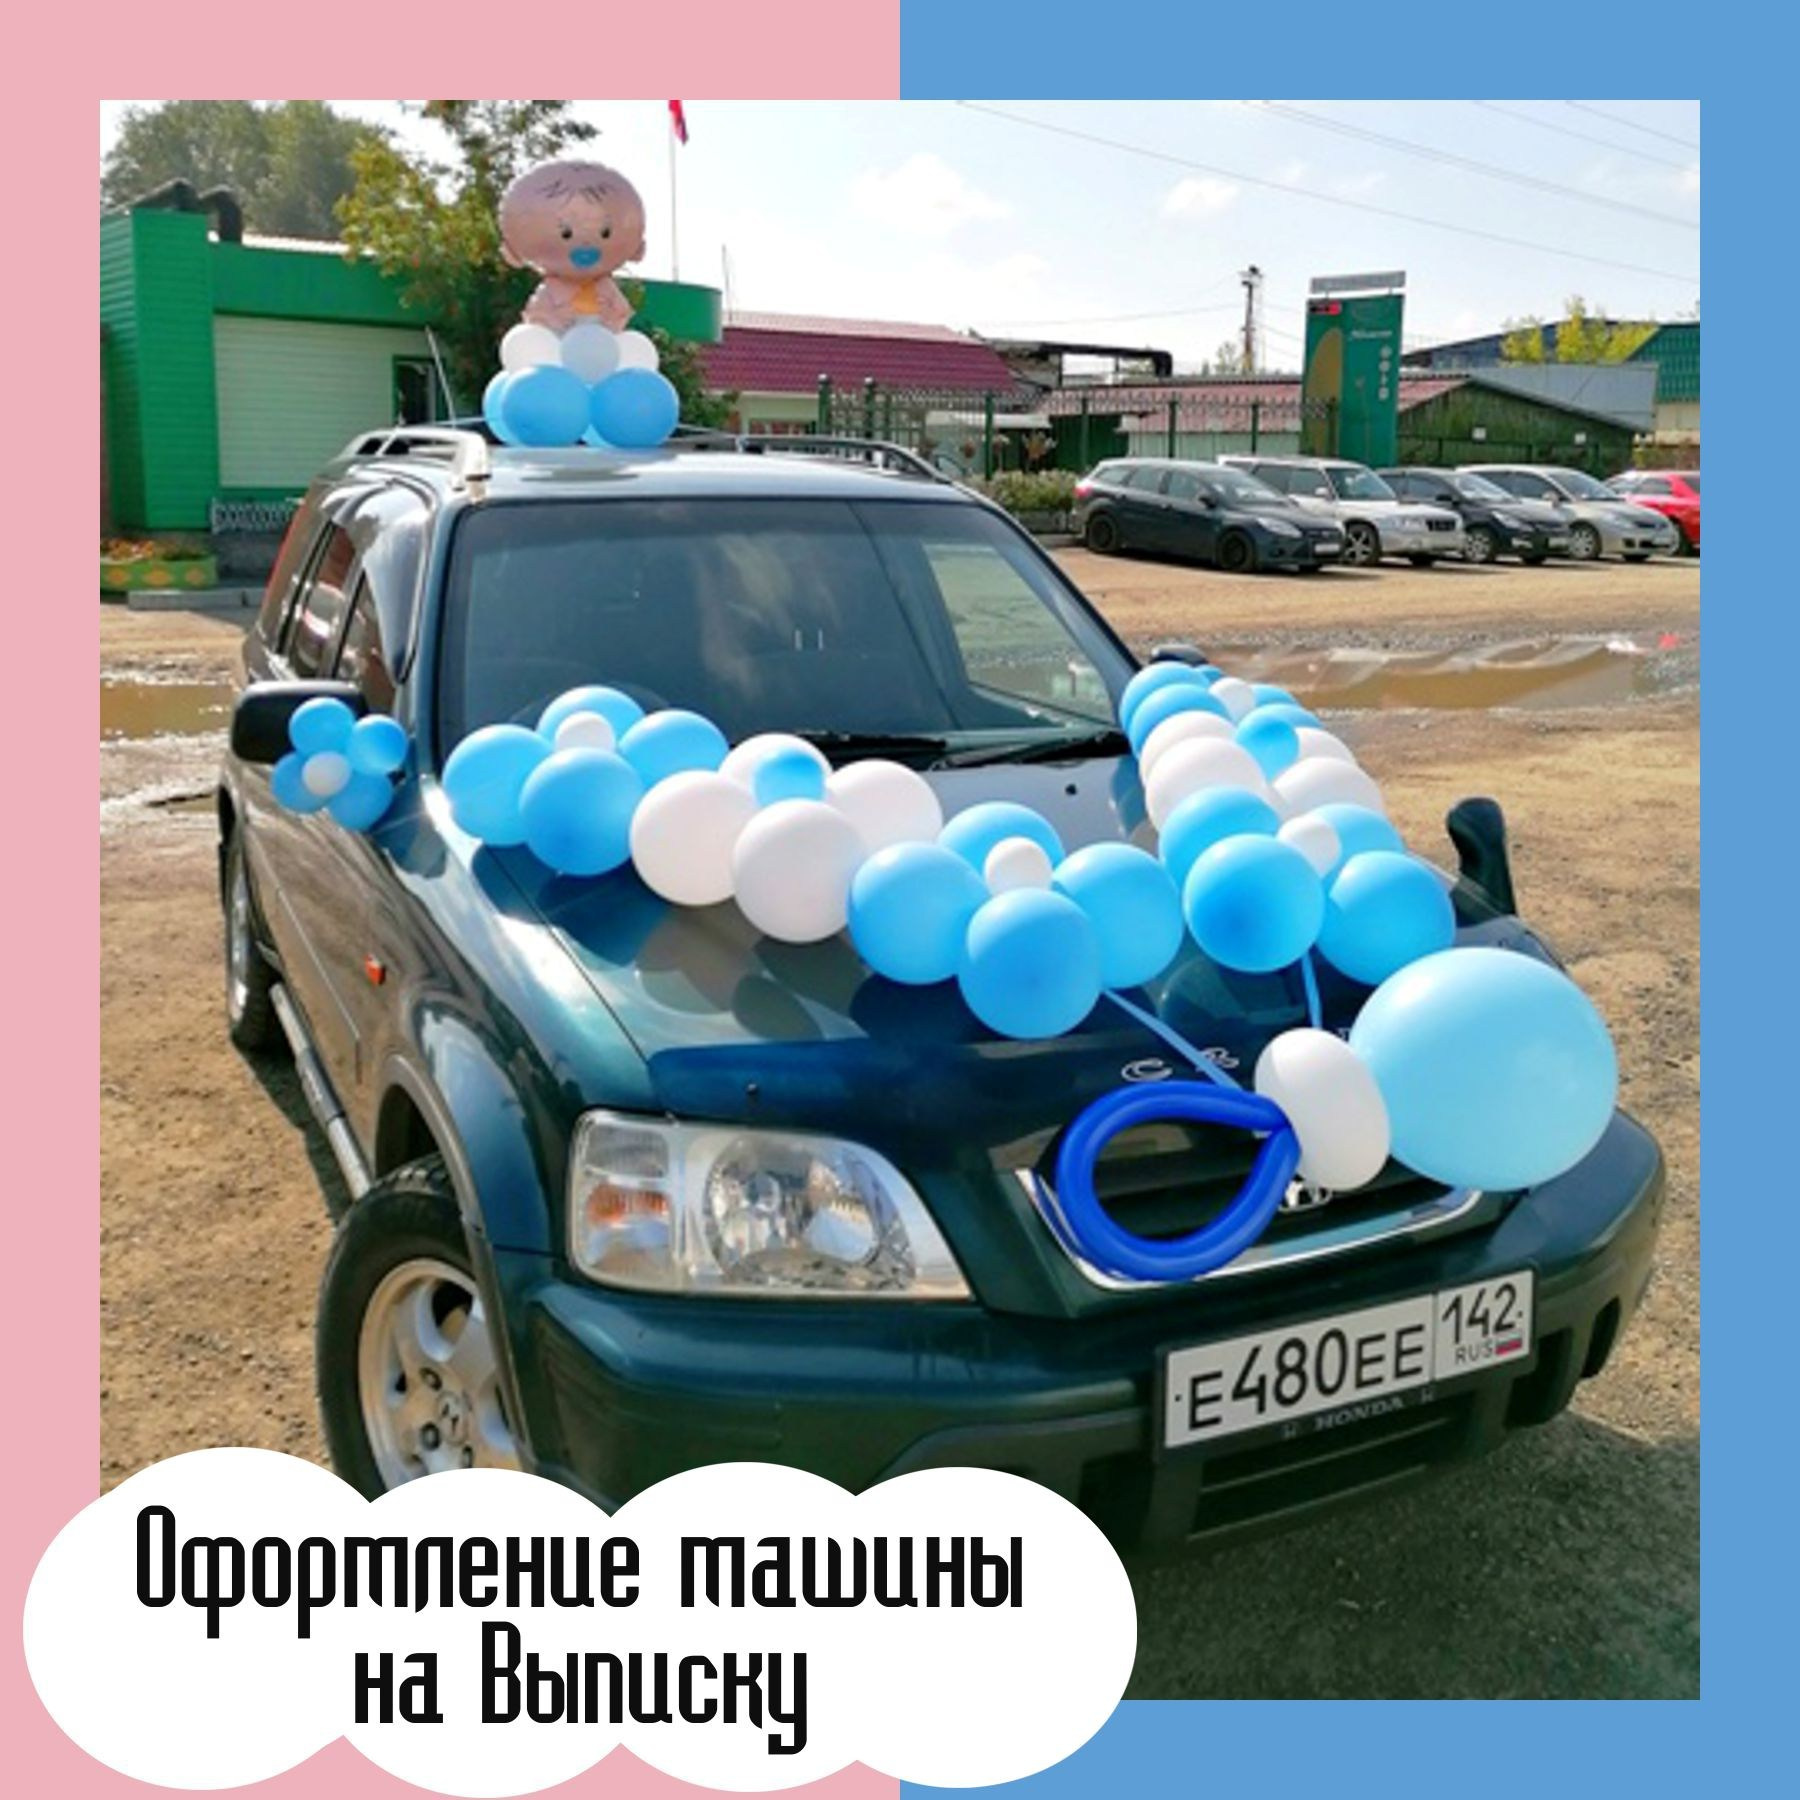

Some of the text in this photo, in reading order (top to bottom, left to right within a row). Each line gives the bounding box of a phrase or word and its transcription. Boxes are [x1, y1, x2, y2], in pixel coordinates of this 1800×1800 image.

[1441, 1283, 1517, 1344] 142
[1455, 1341, 1494, 1366] RUS
[1314, 1397, 1405, 1430] HONDA
